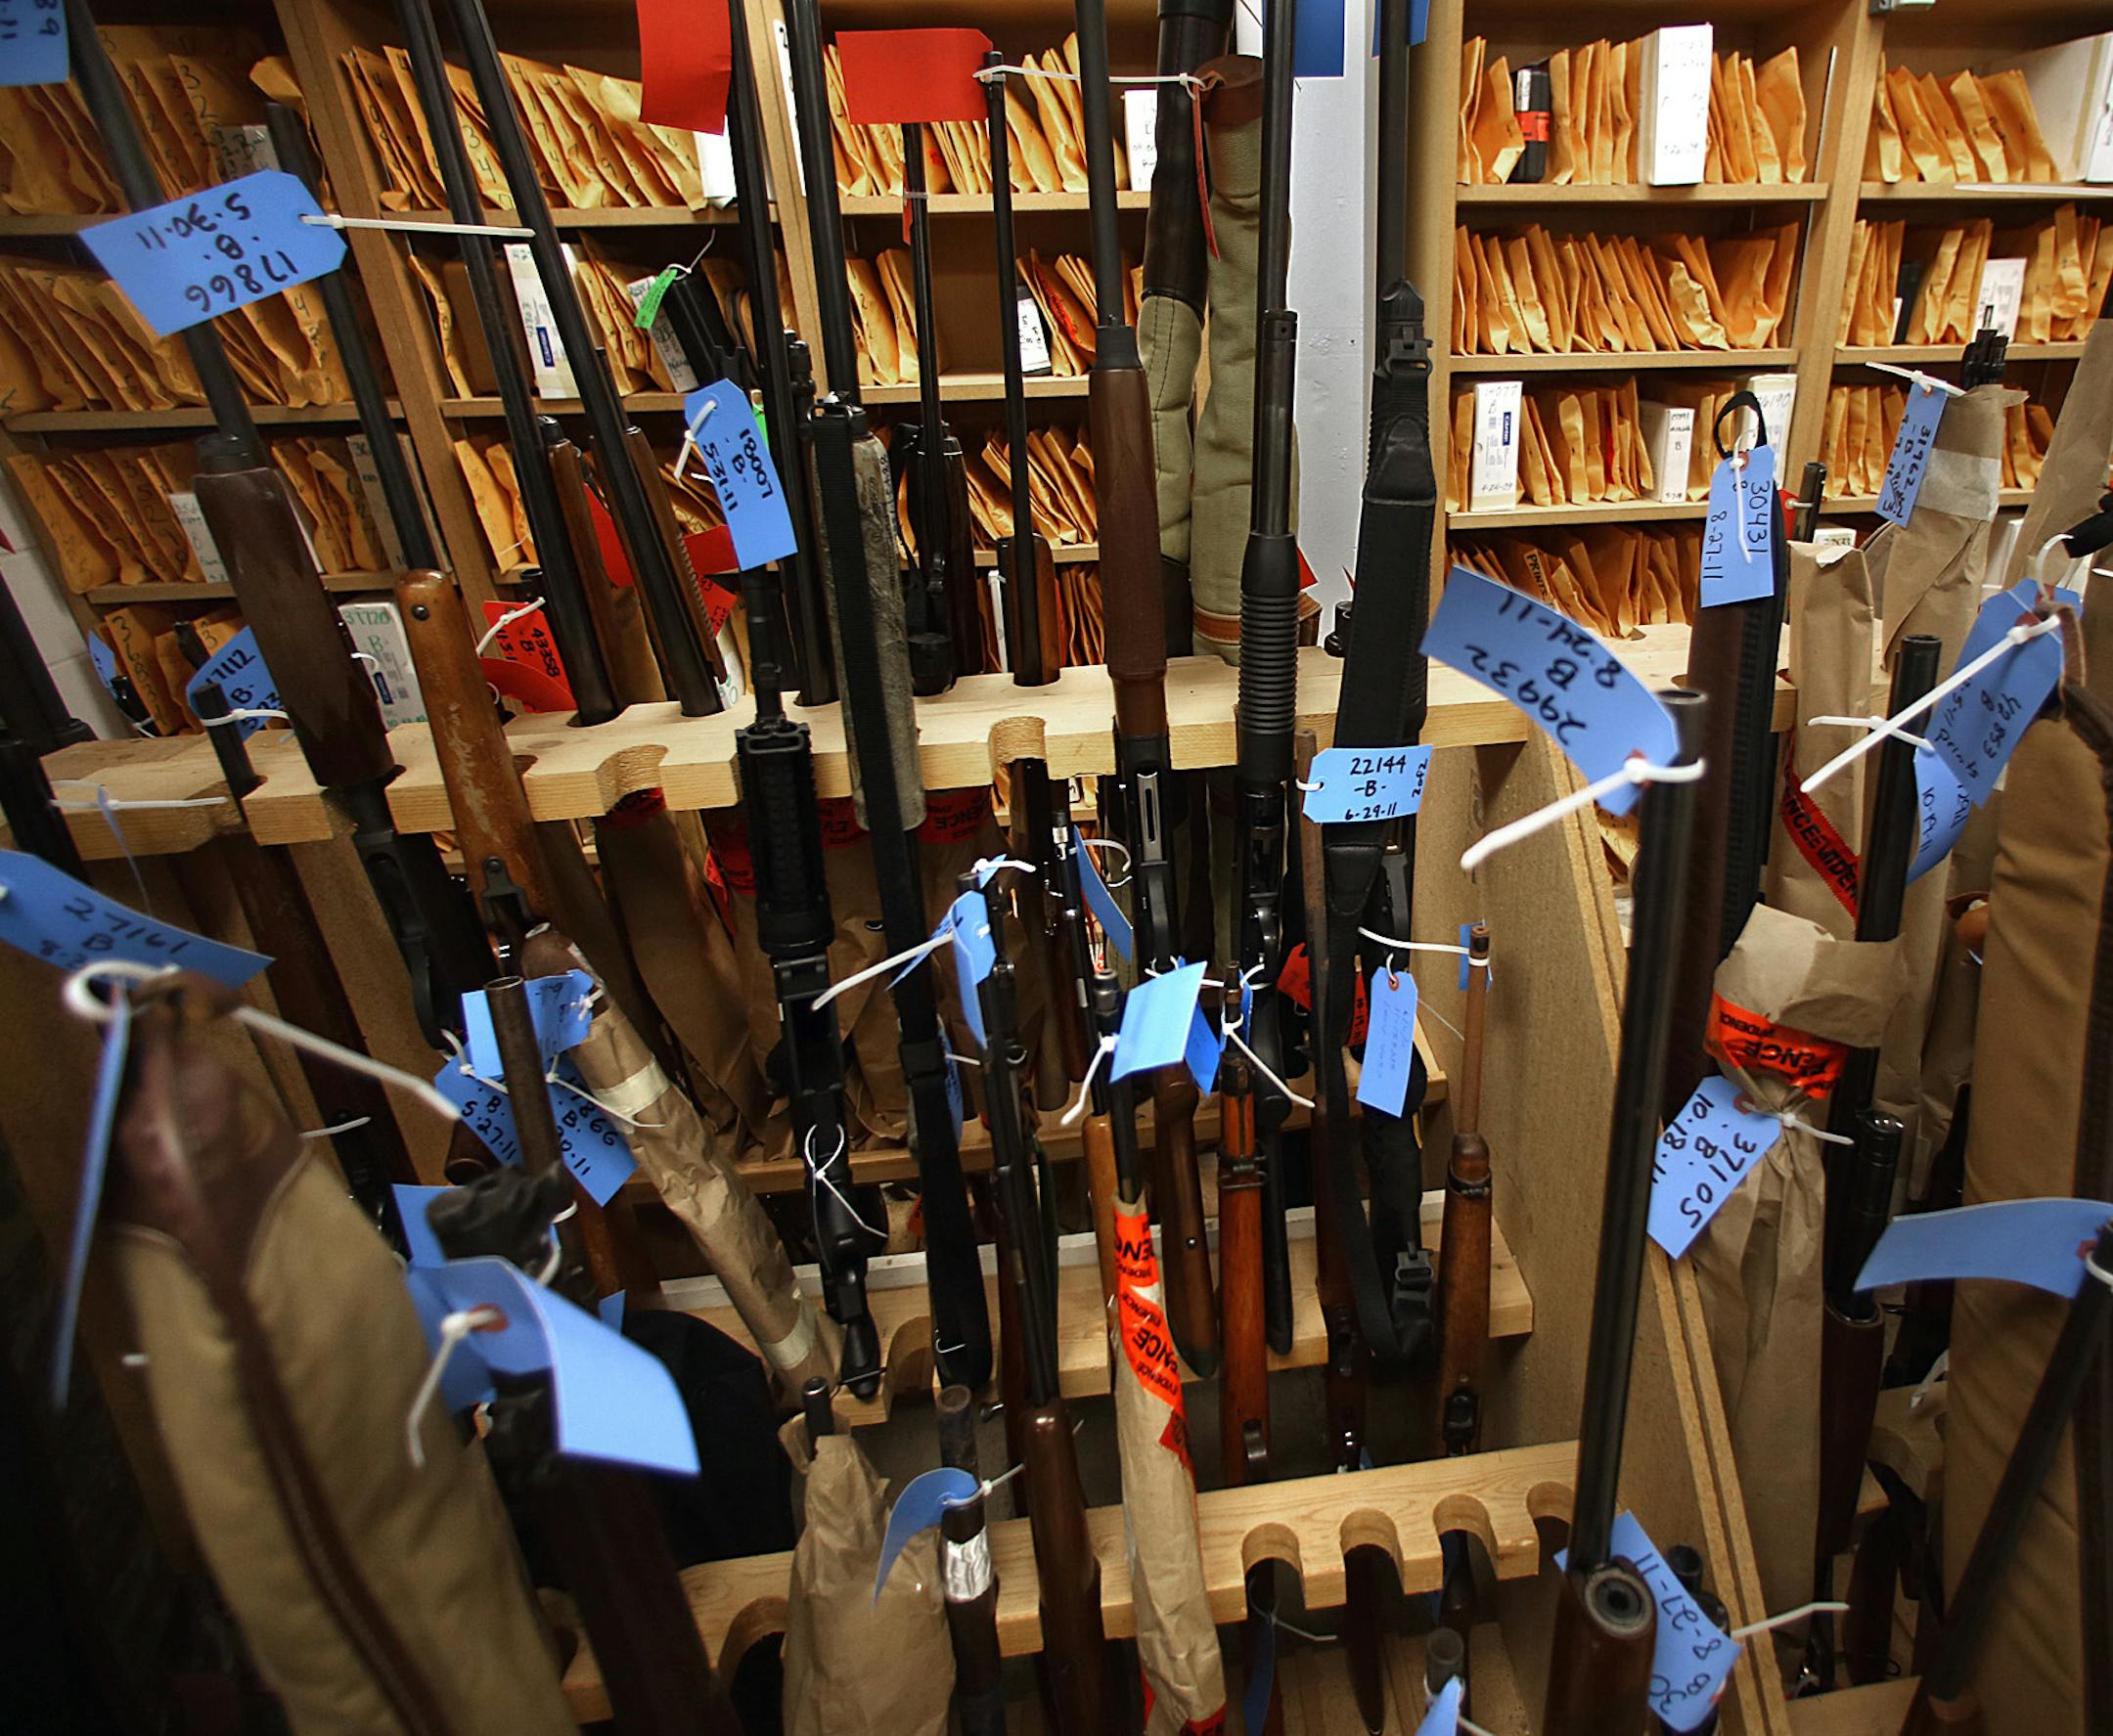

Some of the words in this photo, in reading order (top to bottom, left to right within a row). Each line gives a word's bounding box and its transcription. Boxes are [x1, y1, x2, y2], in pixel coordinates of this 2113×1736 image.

[185, 249, 298, 313] 17866
[739, 427, 774, 500] 18007
[1702, 509, 1728, 580] 8-27-11
[1747, 479, 1771, 554] 30431
[1463, 645, 1587, 747] 29932
[1546, 657, 1578, 691] B
[1349, 754, 1407, 776] 22144
[64, 897, 191, 955] 27161
[1679, 1132, 1759, 1229] 37105
[1634, 1552, 1723, 1661] 8-27-11
